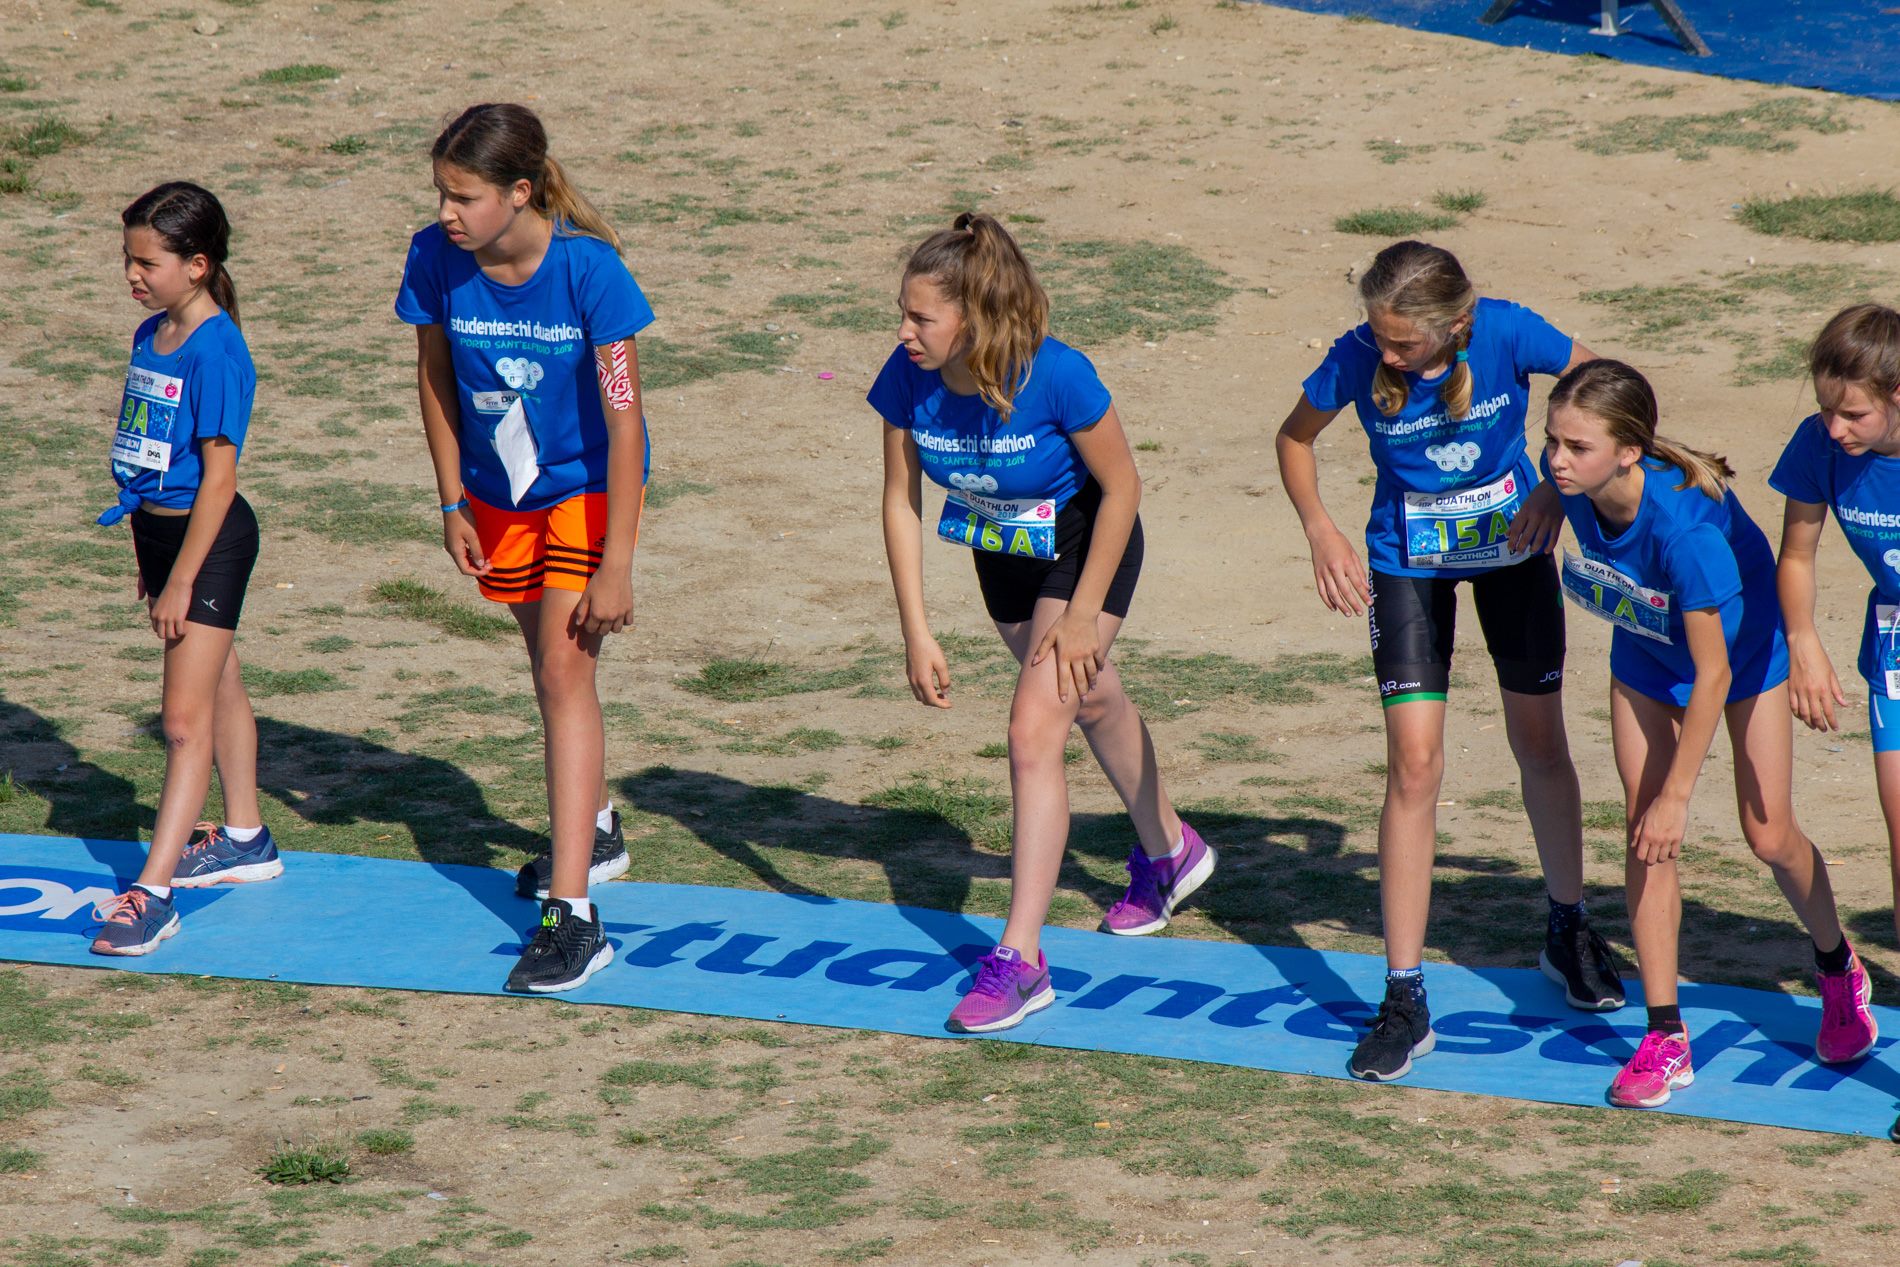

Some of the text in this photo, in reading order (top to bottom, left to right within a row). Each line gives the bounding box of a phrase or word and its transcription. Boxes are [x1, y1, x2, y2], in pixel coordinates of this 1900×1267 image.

[451, 316, 583, 342] studenteschi duathlon
[460, 338, 491, 349] PORTO
[1376, 408, 1459, 435] studentesch
[980, 433, 1036, 453] duathlon
[969, 493, 1019, 512] DUATHLON
[1435, 489, 1491, 506] DUATHLON
[1443, 549, 1498, 563] DECATHLON
[1584, 562, 1635, 591] DUATHLON
